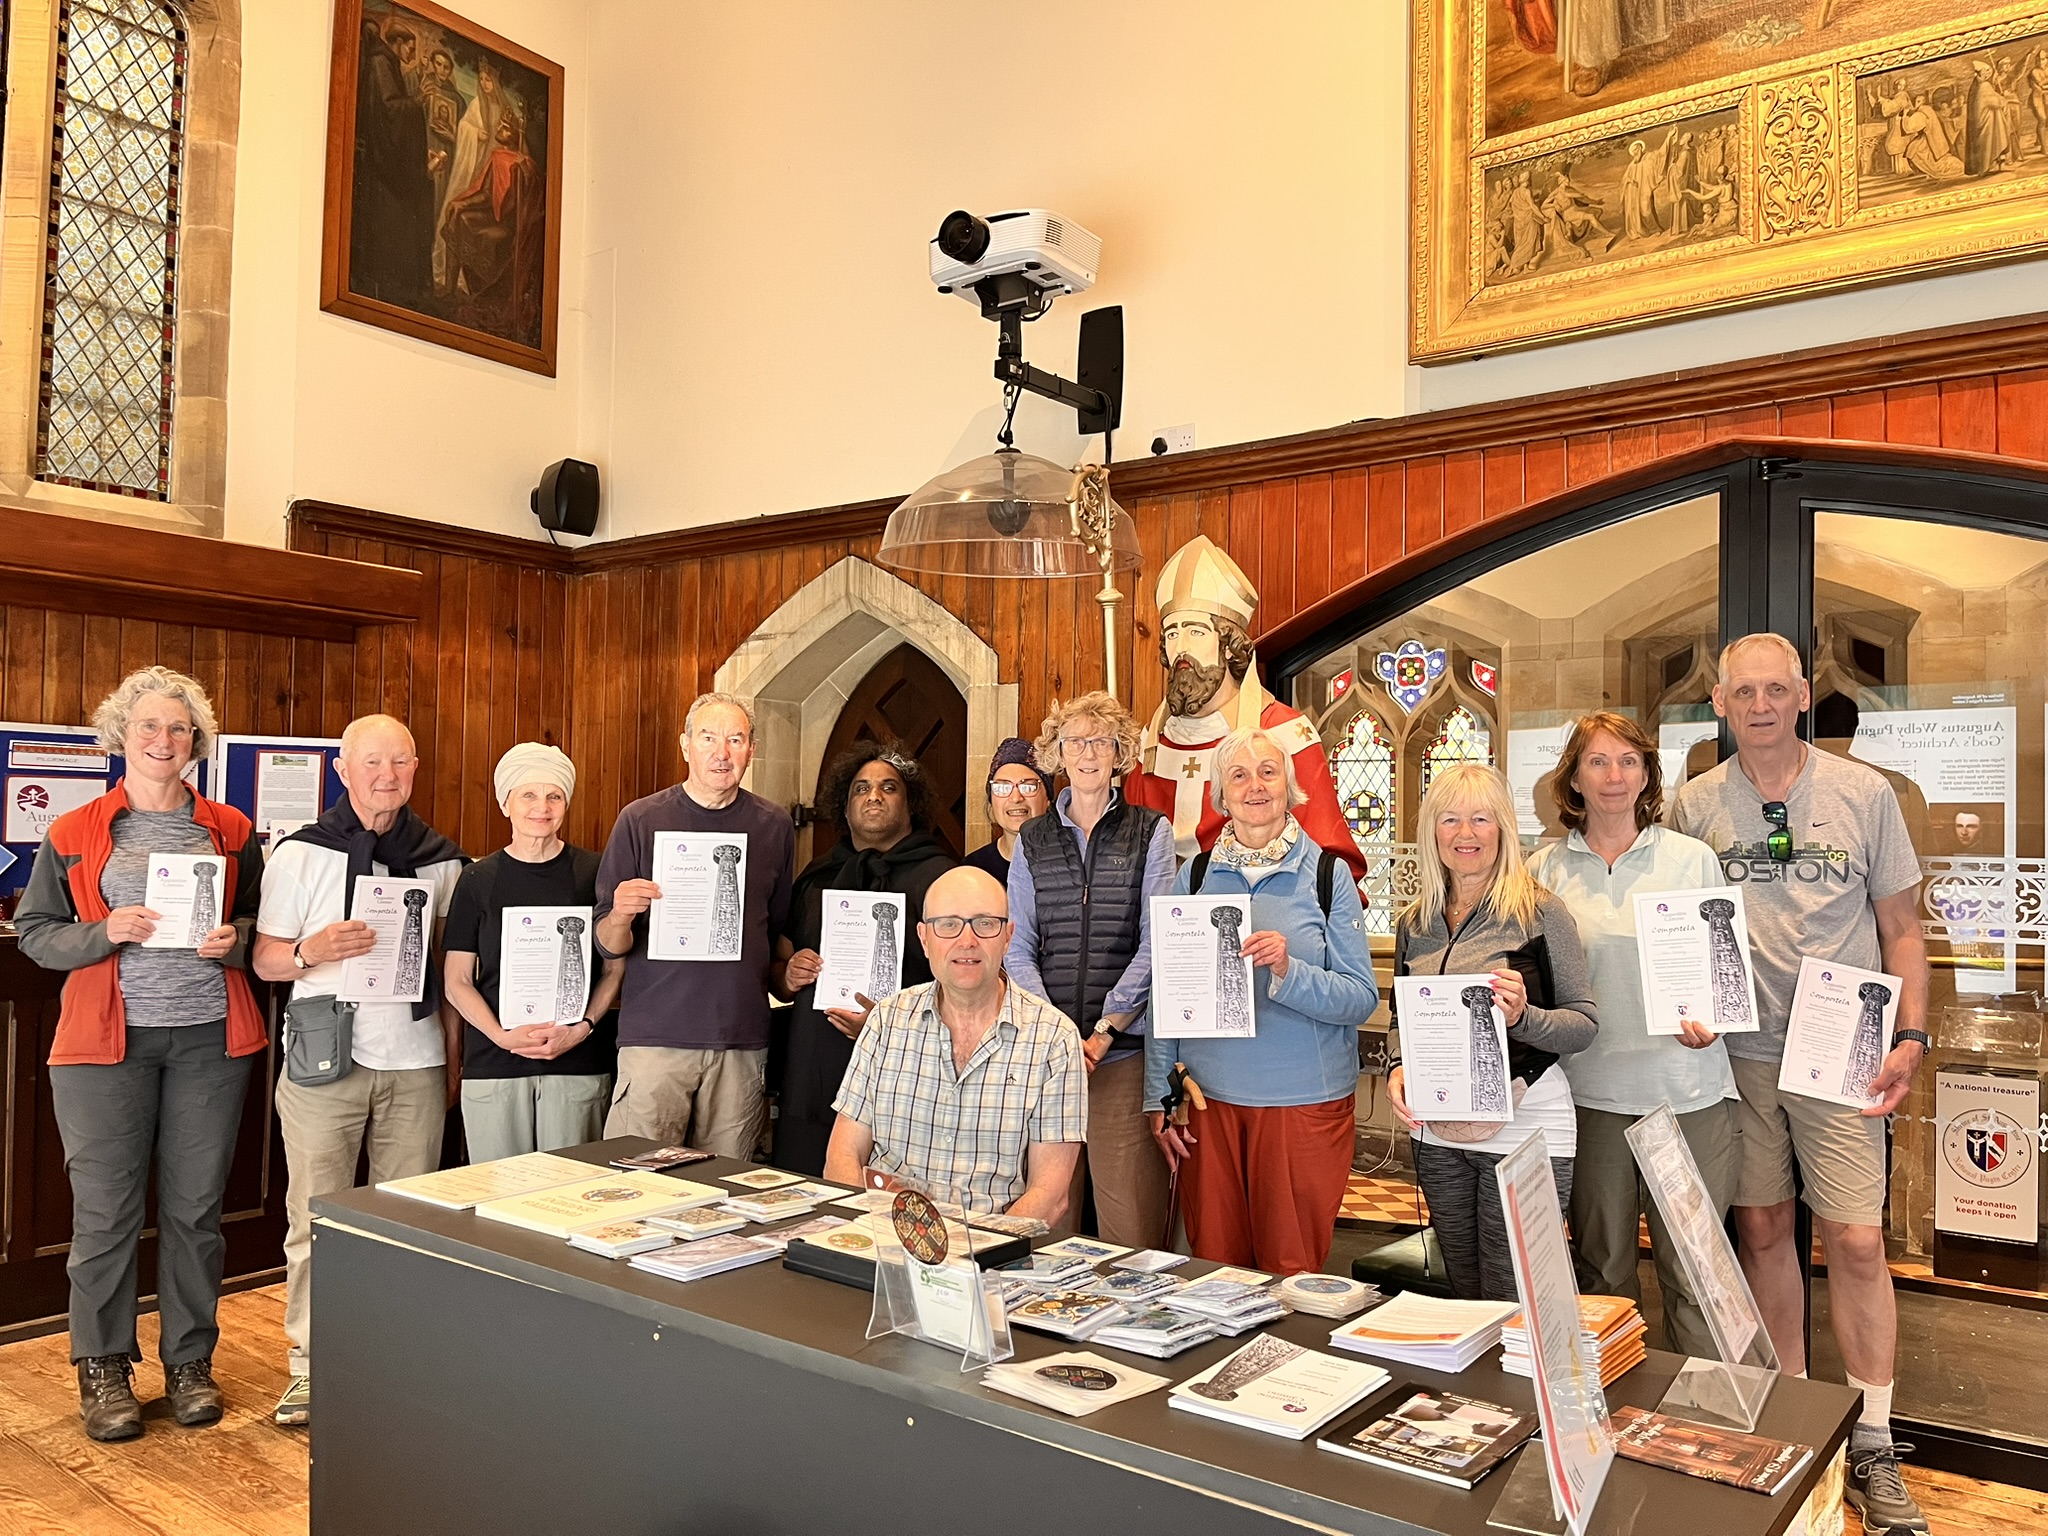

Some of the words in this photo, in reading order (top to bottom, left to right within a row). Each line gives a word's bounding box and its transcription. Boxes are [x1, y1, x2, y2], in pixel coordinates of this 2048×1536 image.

[669, 865, 707, 874] Compostela
[1720, 859, 1849, 884] OSTON
[365, 907, 398, 917] Compostela
[834, 920, 867, 928] Compostela
[1165, 930, 1206, 940] Compostela
[1652, 925, 1696, 936] Compostela
[515, 937, 551, 945] Compostela
[1810, 992, 1850, 1006] Compostela
[1414, 1010, 1457, 1020] Compostela
[1954, 1083, 1990, 1093] national
[1953, 1195, 1974, 1206] Your
[1977, 1198, 2017, 1211] donation
[1956, 1206, 1982, 1217] keeps
[1985, 1208, 1991, 1217] it
[1994, 1211, 2017, 1220] open
